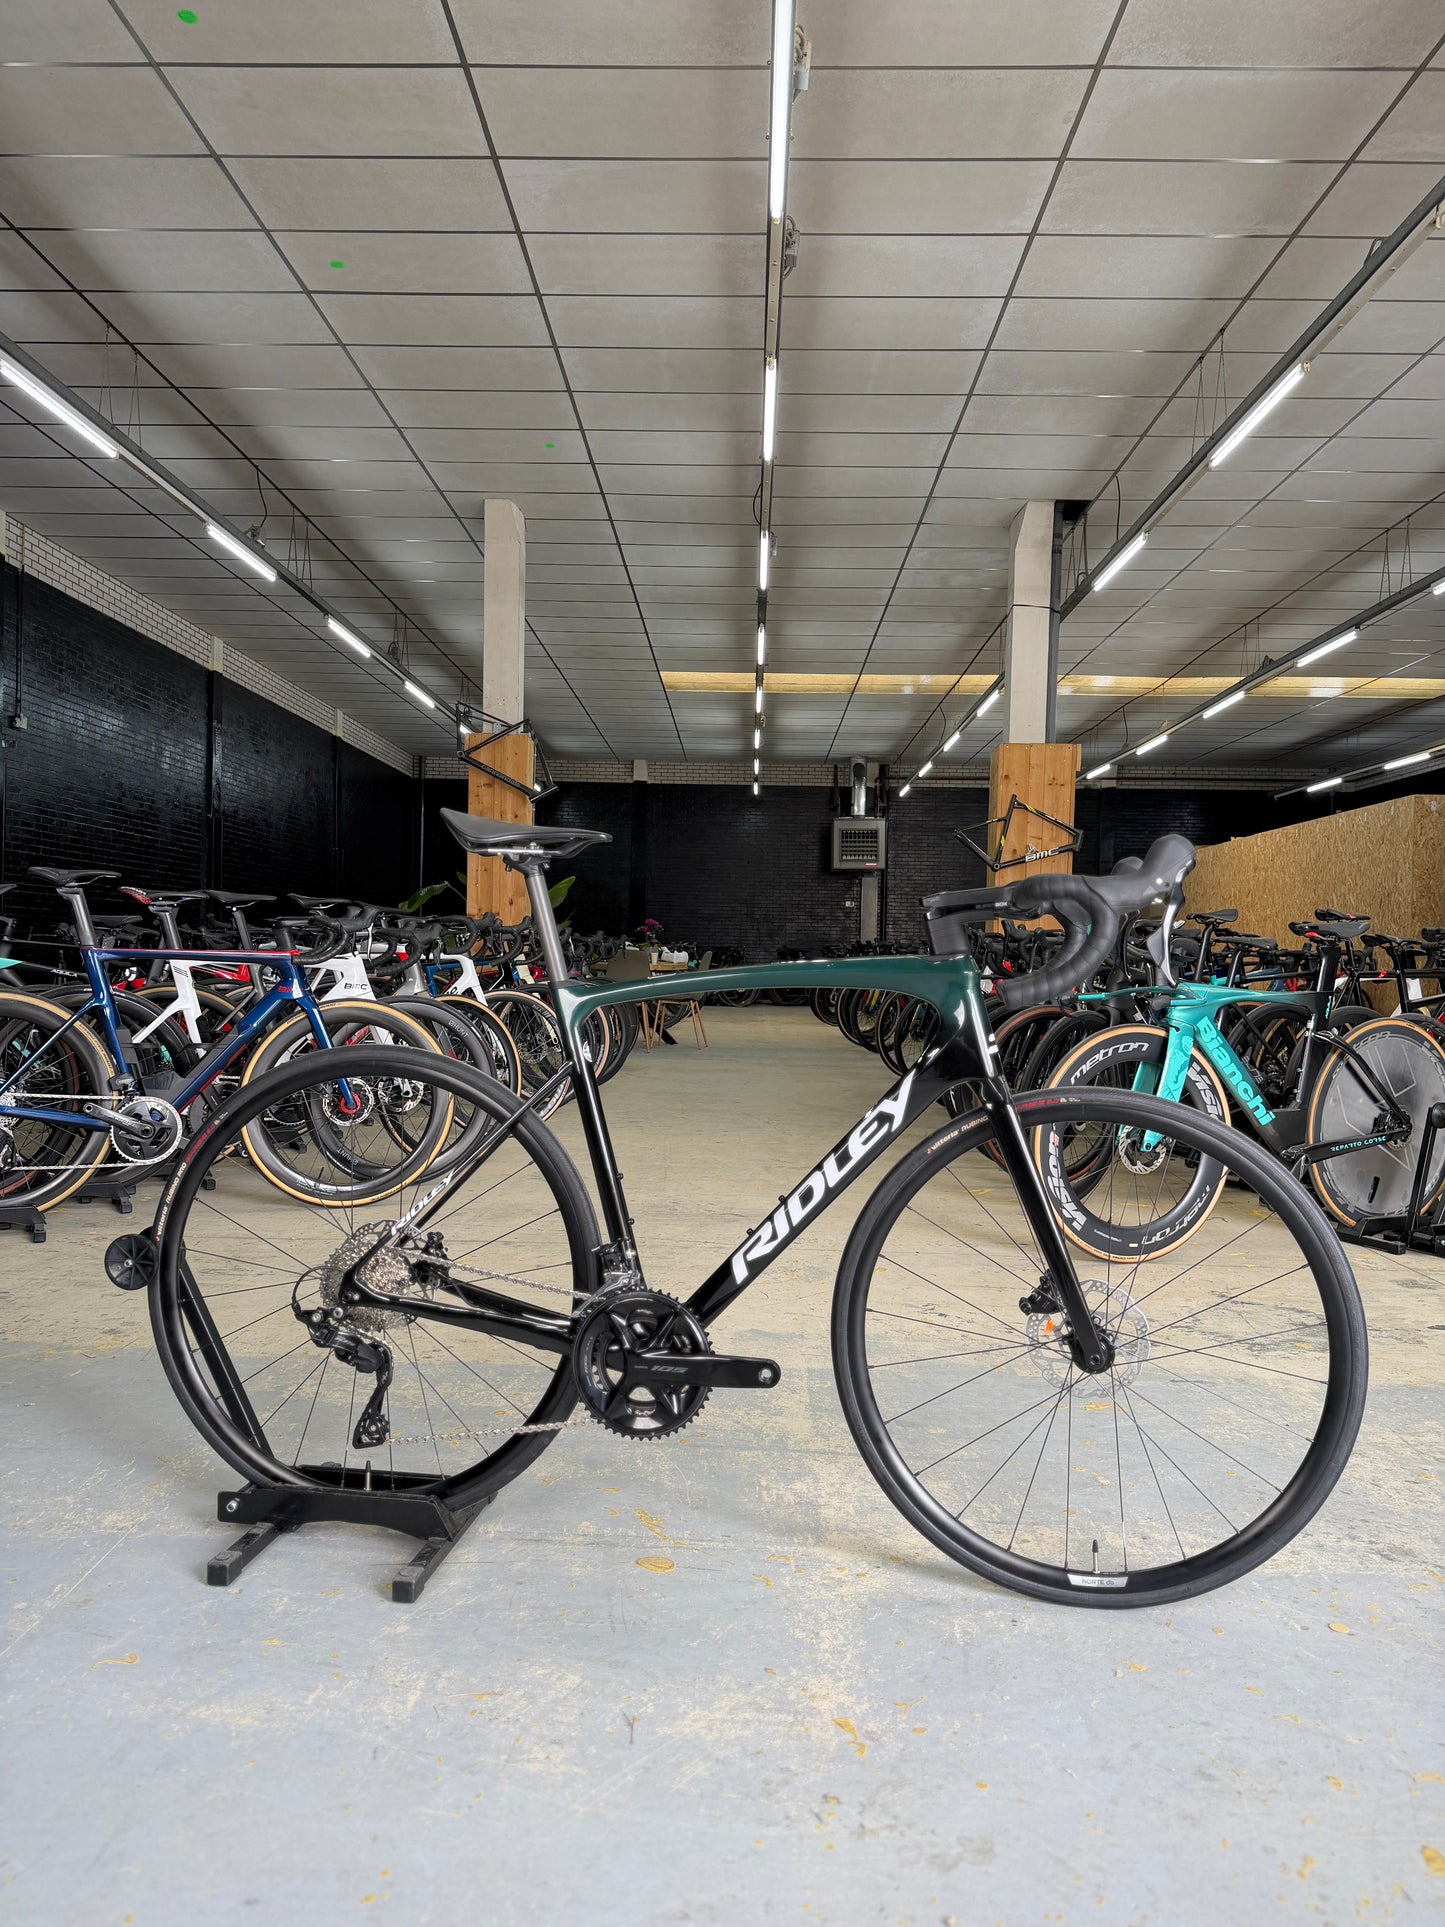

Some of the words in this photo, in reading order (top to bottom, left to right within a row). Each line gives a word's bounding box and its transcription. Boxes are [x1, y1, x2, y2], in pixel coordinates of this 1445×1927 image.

[1025, 847, 1060, 862] BMC
[343, 982, 368, 990] BMC
[1071, 1042, 1149, 1085] metron
[1196, 1016, 1276, 1126] Bianchi
[391, 1169, 454, 1236] RIDLEY
[732, 1068, 916, 1285] RIDLEY
